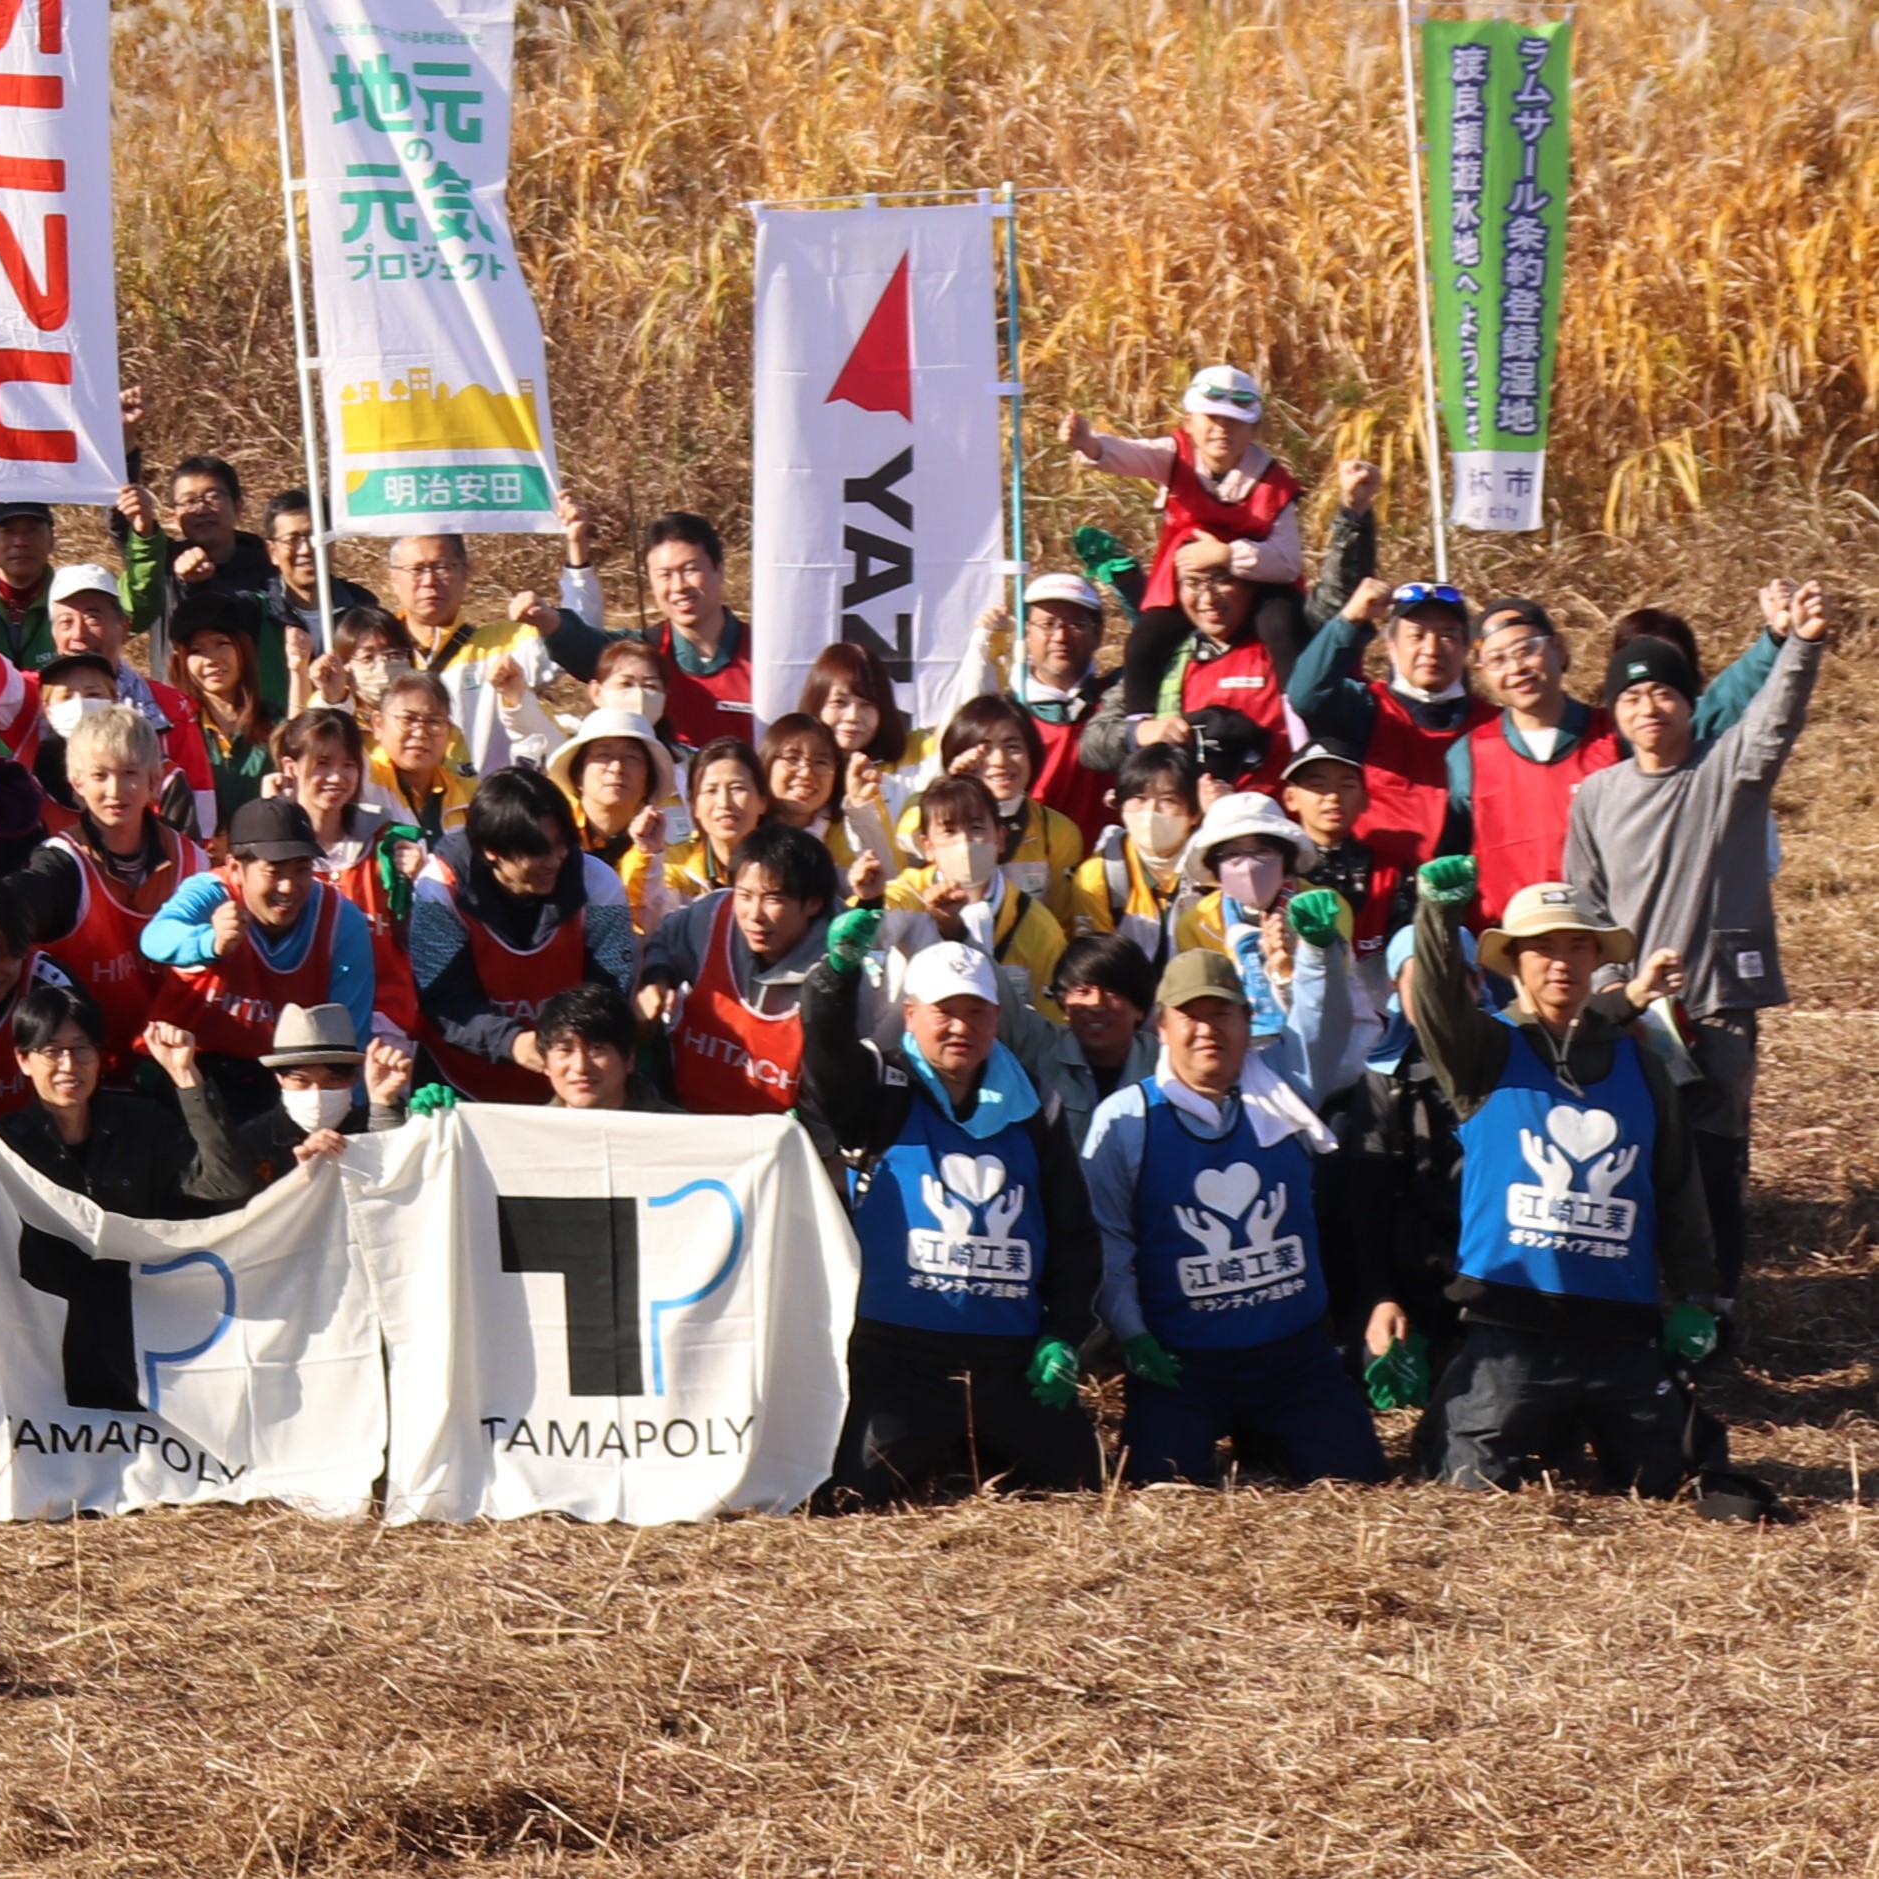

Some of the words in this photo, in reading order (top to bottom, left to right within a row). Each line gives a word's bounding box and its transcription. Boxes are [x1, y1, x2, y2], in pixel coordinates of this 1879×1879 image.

[330, 53, 484, 144] 地元
[403, 138, 433, 162] の
[339, 161, 496, 244] 元気
[1497, 36, 1552, 435] ラムサール条約登録湿地
[345, 243, 507, 281] プロジェクト
[384, 471, 522, 506] 明治安田
[842, 445, 914, 731] YAZ
[683, 1024, 799, 1090] HITACH
[8, 1416, 246, 1484] AMAPOLY
[482, 1415, 754, 1459] TAMAPOLY
